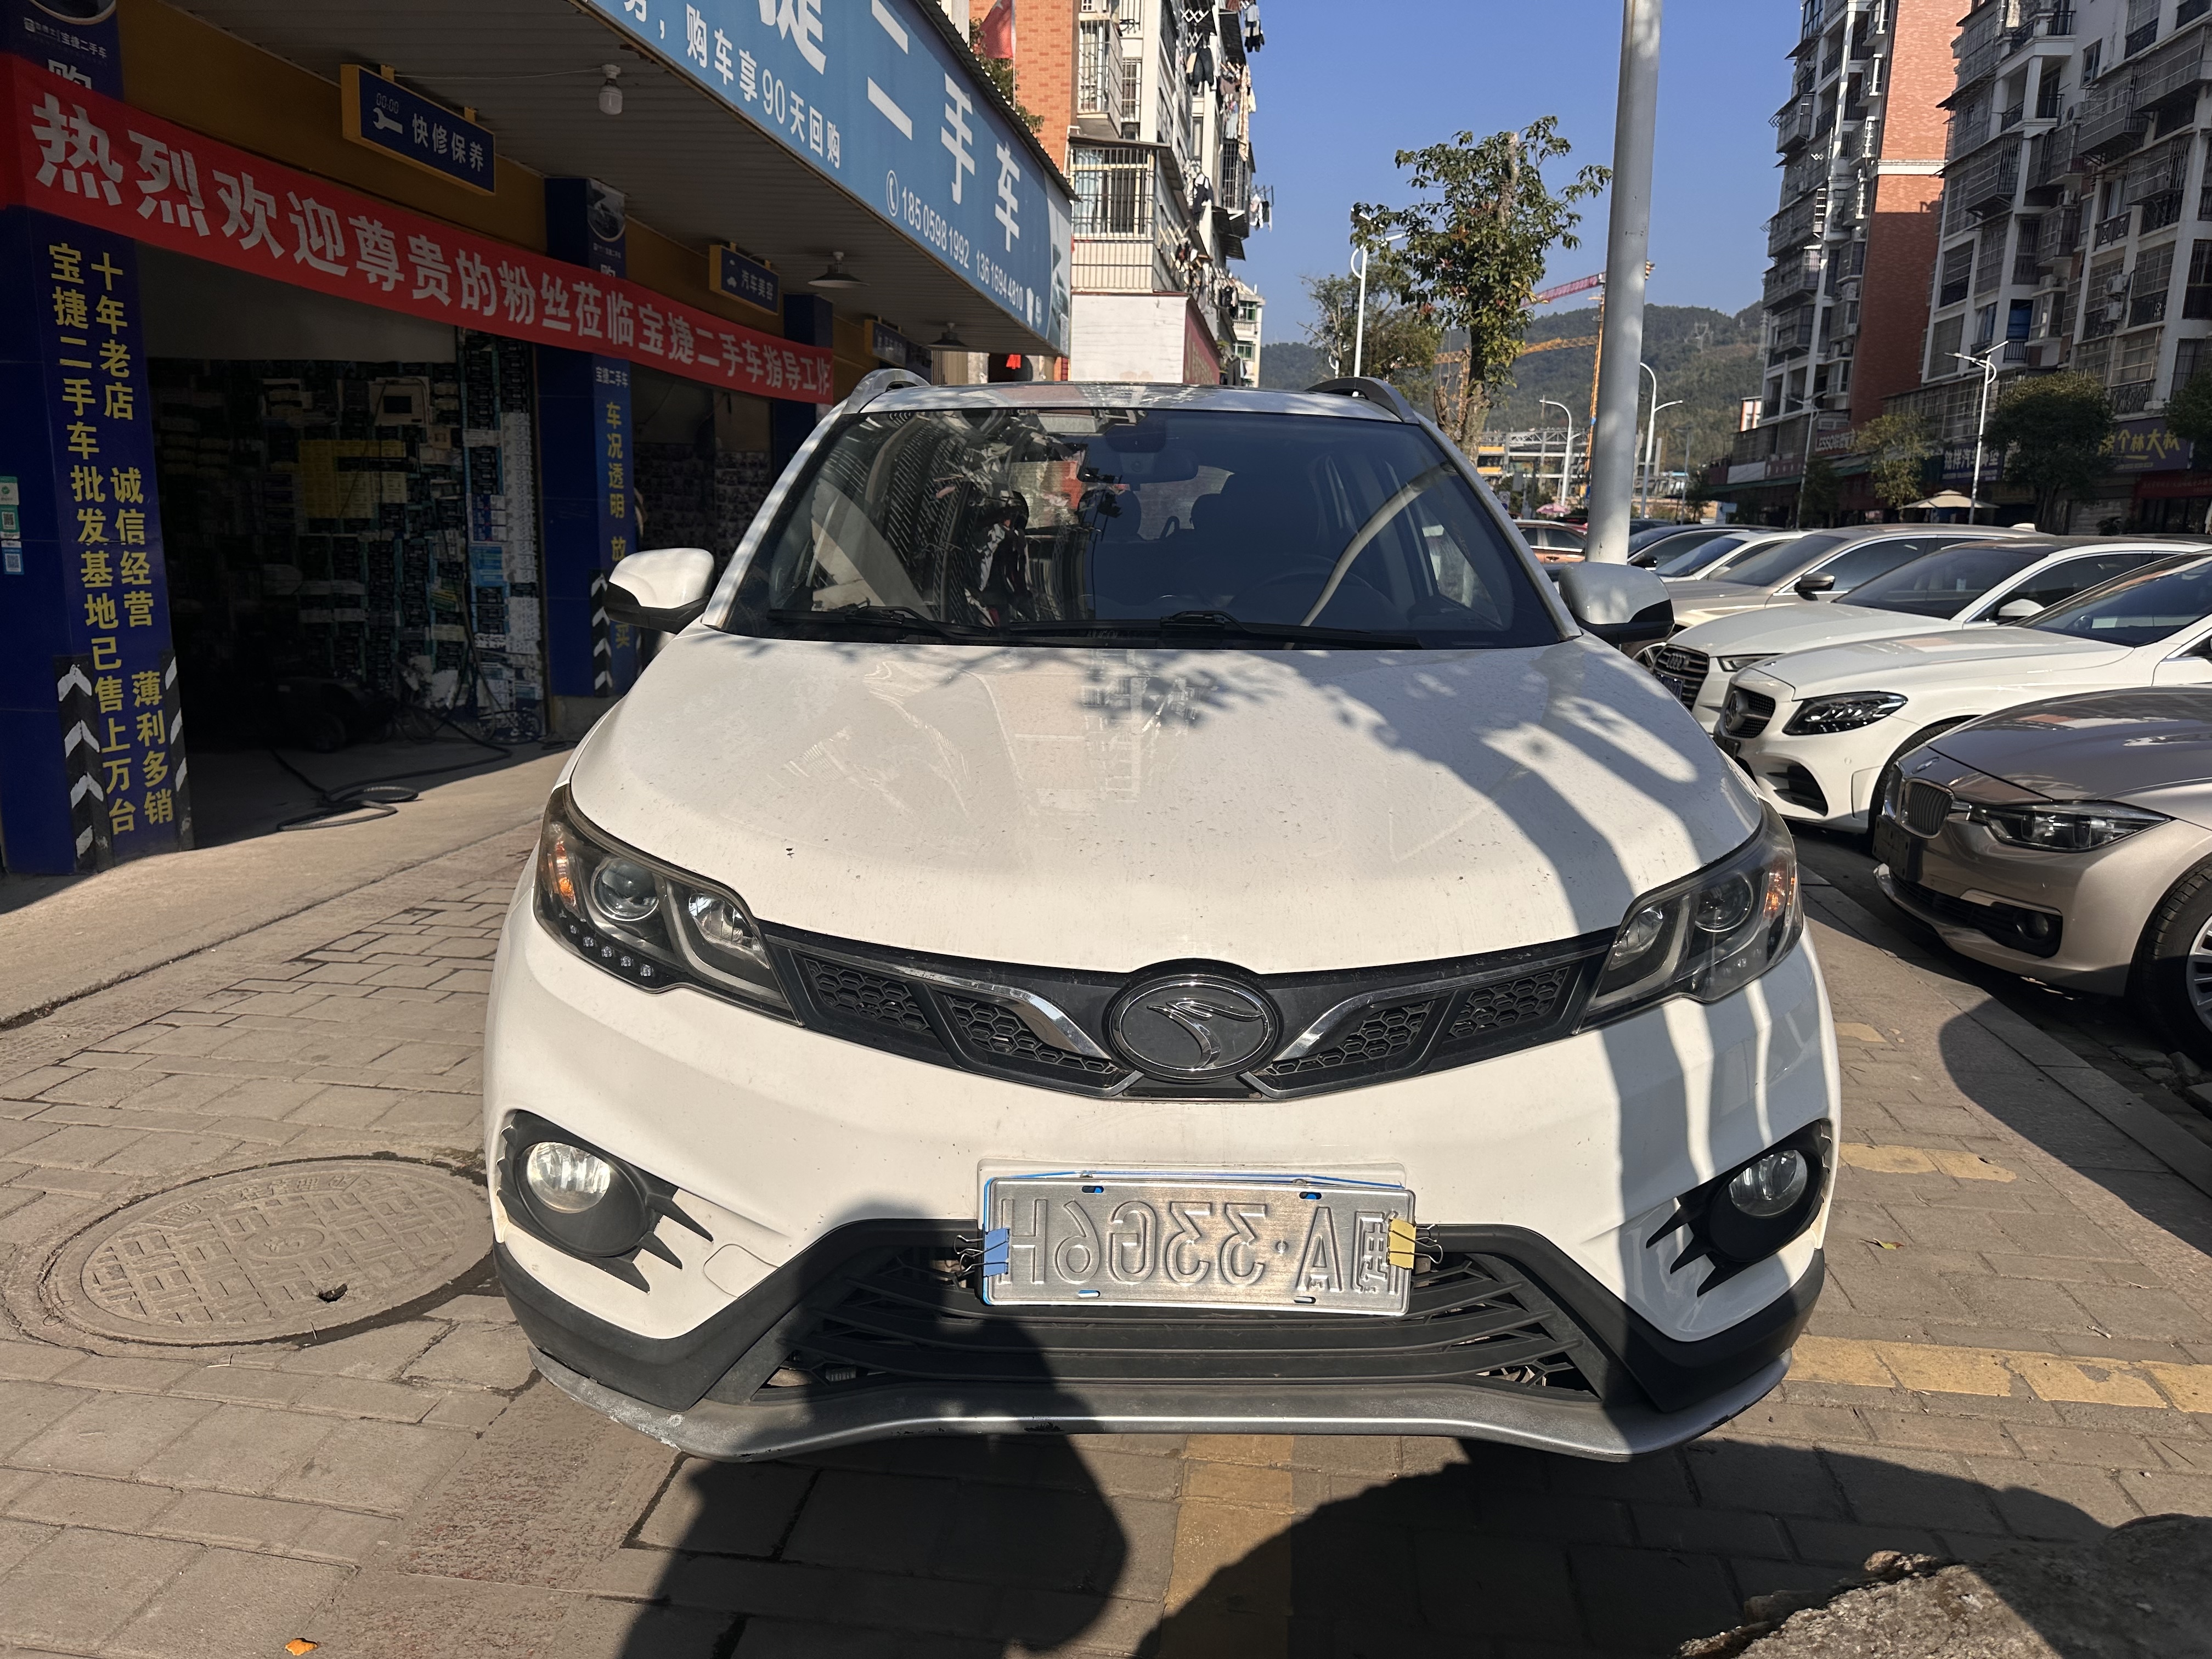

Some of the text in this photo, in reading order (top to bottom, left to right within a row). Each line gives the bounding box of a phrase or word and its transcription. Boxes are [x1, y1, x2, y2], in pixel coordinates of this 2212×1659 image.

[61, 32, 108, 59] 宝捷二手车
[413, 113, 483, 172] 快修保养
[31, 92, 831, 395] 热烈欢迎尊贵的粉丝莅临宝捷二手车指导工作
[49, 243, 136, 835] 宝捷二手车批发基地已售上万台
[91, 252, 174, 825] 十年老店 诚信经营 薄利多销
[606, 402, 625, 519] 车况透明
